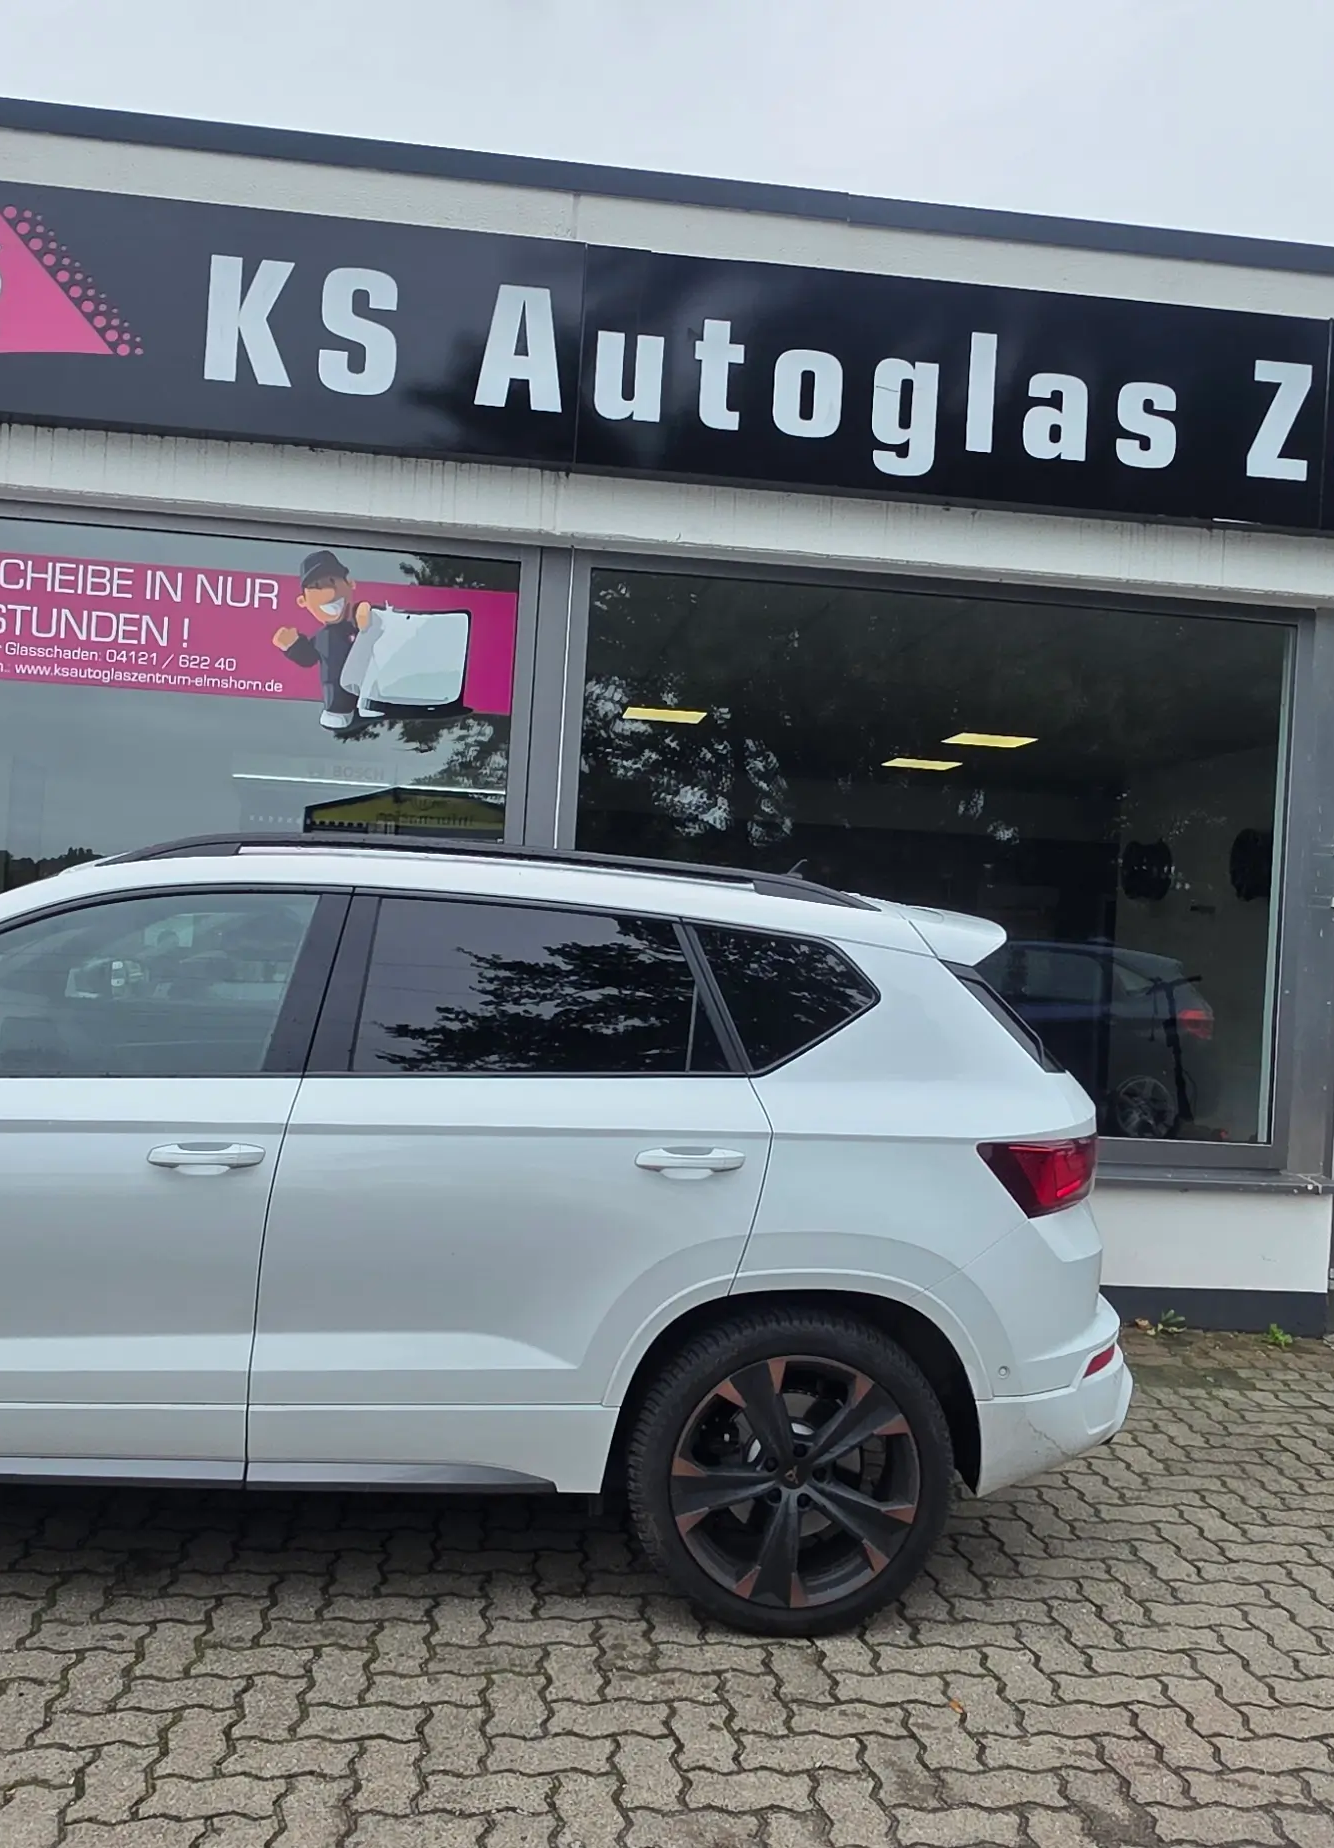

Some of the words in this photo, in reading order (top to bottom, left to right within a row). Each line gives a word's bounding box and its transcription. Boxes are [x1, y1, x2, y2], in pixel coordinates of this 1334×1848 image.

[204, 254, 398, 396] KS
[474, 284, 1178, 477] Autoglas
[145, 569, 183, 603] IN
[195, 573, 279, 610] NUR
[5, 641, 102, 662] Glasschaden:
[105, 649, 157, 666] 04121
[178, 654, 211, 670] 622
[214, 657, 237, 672] 40
[15, 663, 284, 693] www.ksautoglaszentrum-elmshorn.de
